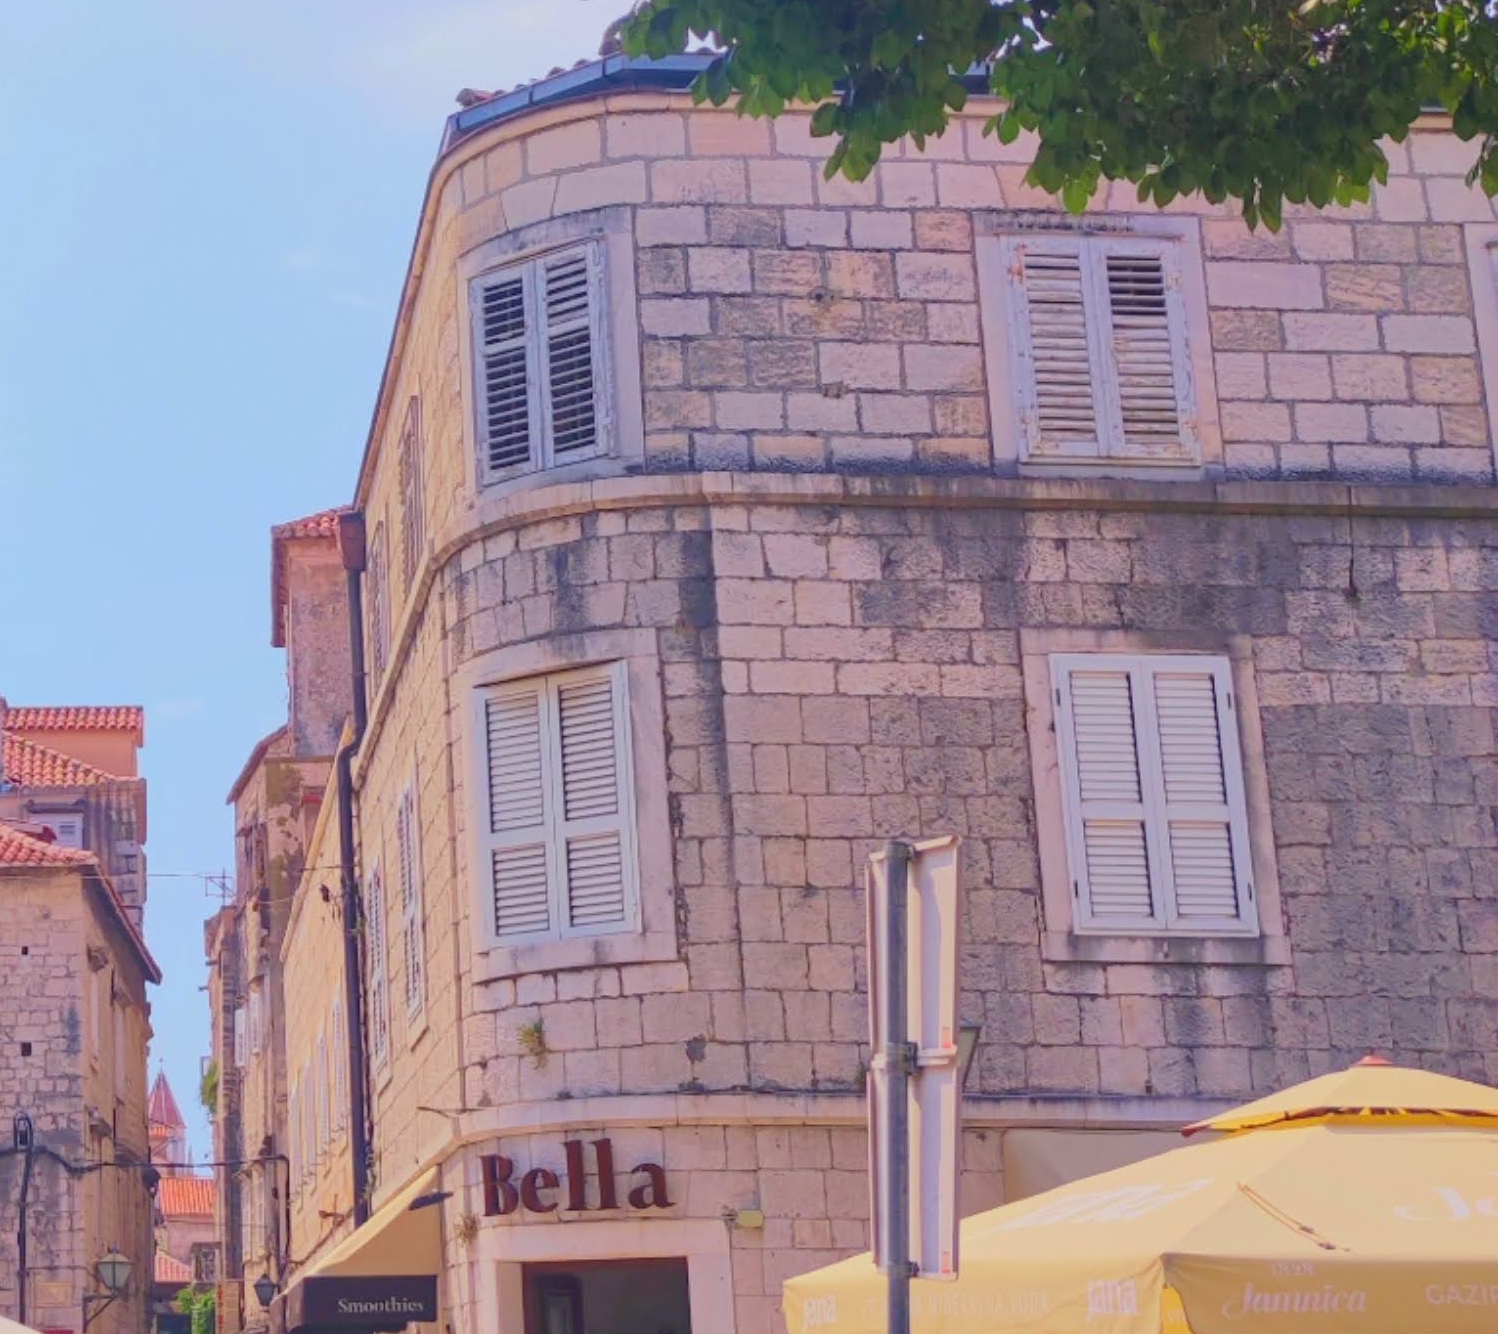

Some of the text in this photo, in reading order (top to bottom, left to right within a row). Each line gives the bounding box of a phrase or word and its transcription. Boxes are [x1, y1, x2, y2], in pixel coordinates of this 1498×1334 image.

[479, 1138, 676, 1217] Bella
[337, 1296, 423, 1314] Smoothies
[1222, 1283, 1367, 1319] Jamnica
